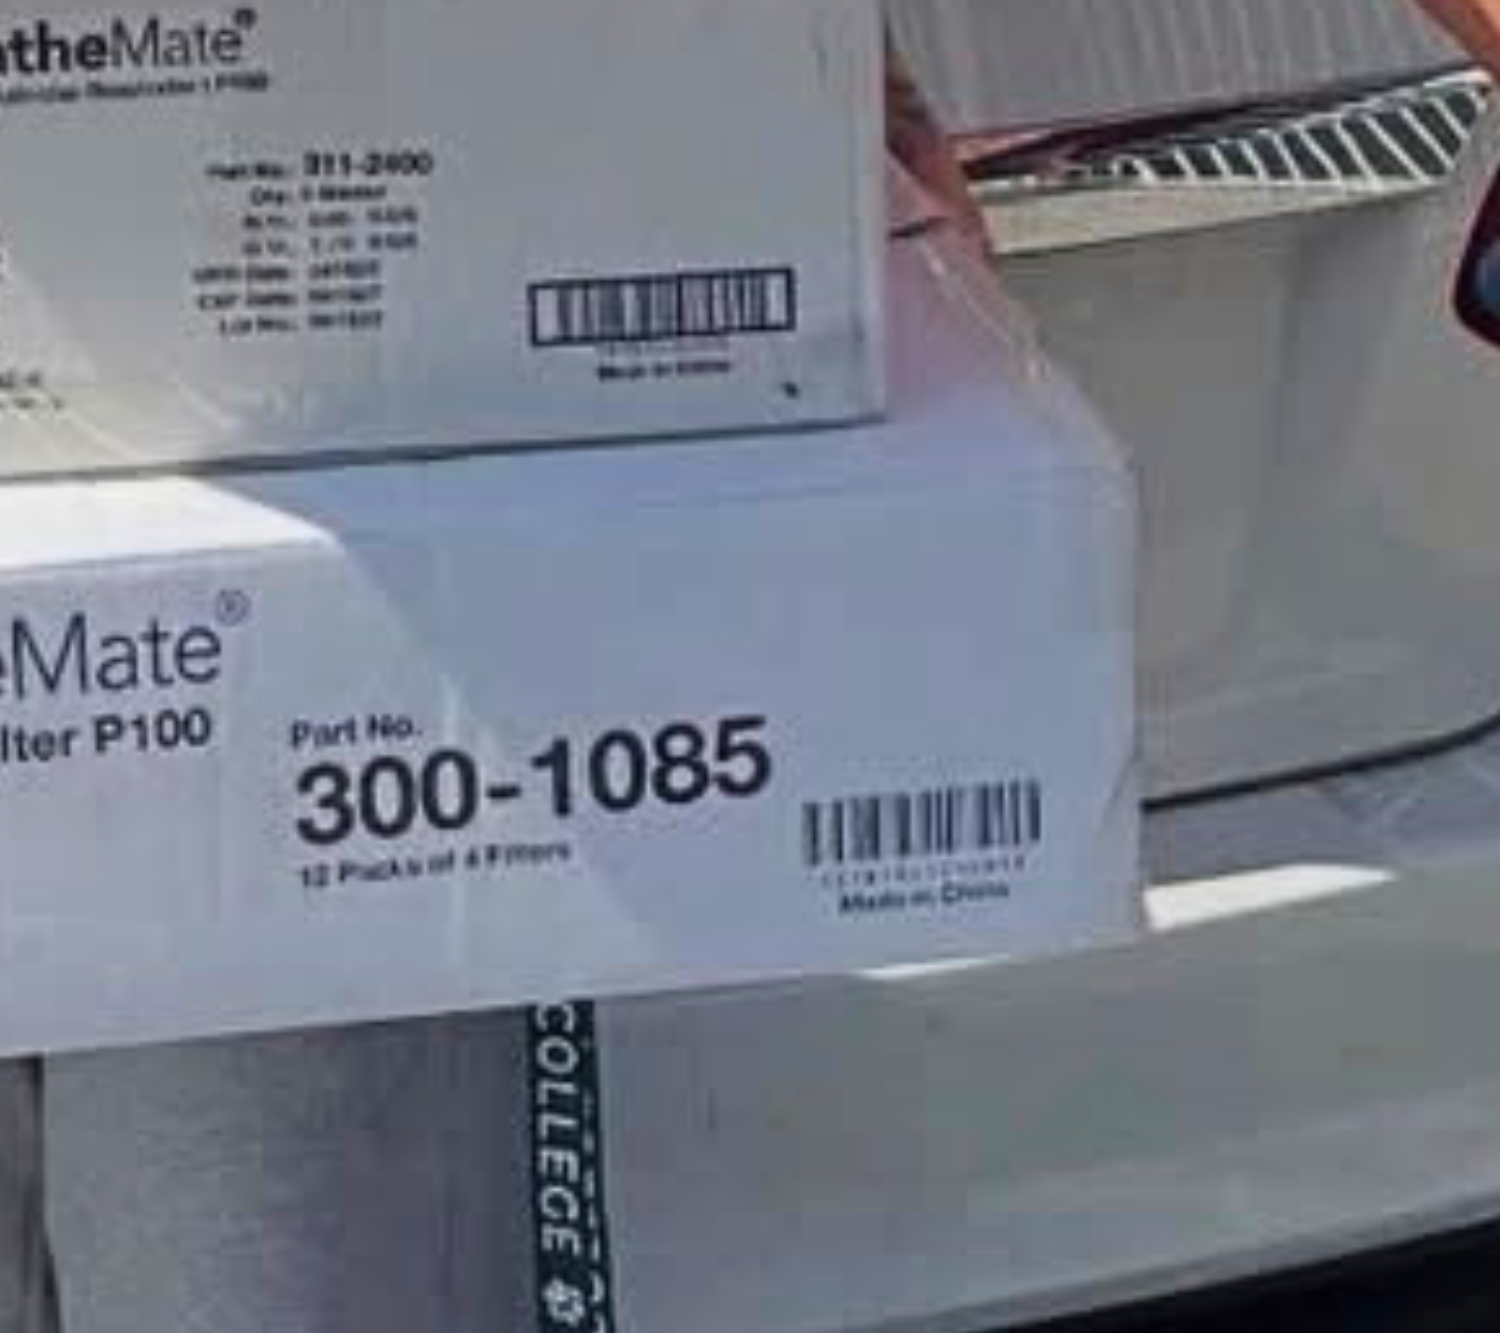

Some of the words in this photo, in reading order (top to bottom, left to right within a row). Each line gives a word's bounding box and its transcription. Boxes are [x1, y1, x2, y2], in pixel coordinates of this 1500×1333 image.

[92, 707, 213, 755] P100
[290, 717, 357, 749] Part
[366, 713, 424, 743] No.
[296, 714, 772, 847] 300-1085
[301, 864, 330, 889] 12
[337, 855, 424, 884] Packs
[428, 847, 455, 874] of
[484, 841, 571, 868] Filters
[535, 1001, 581, 1257] COLLEGE
